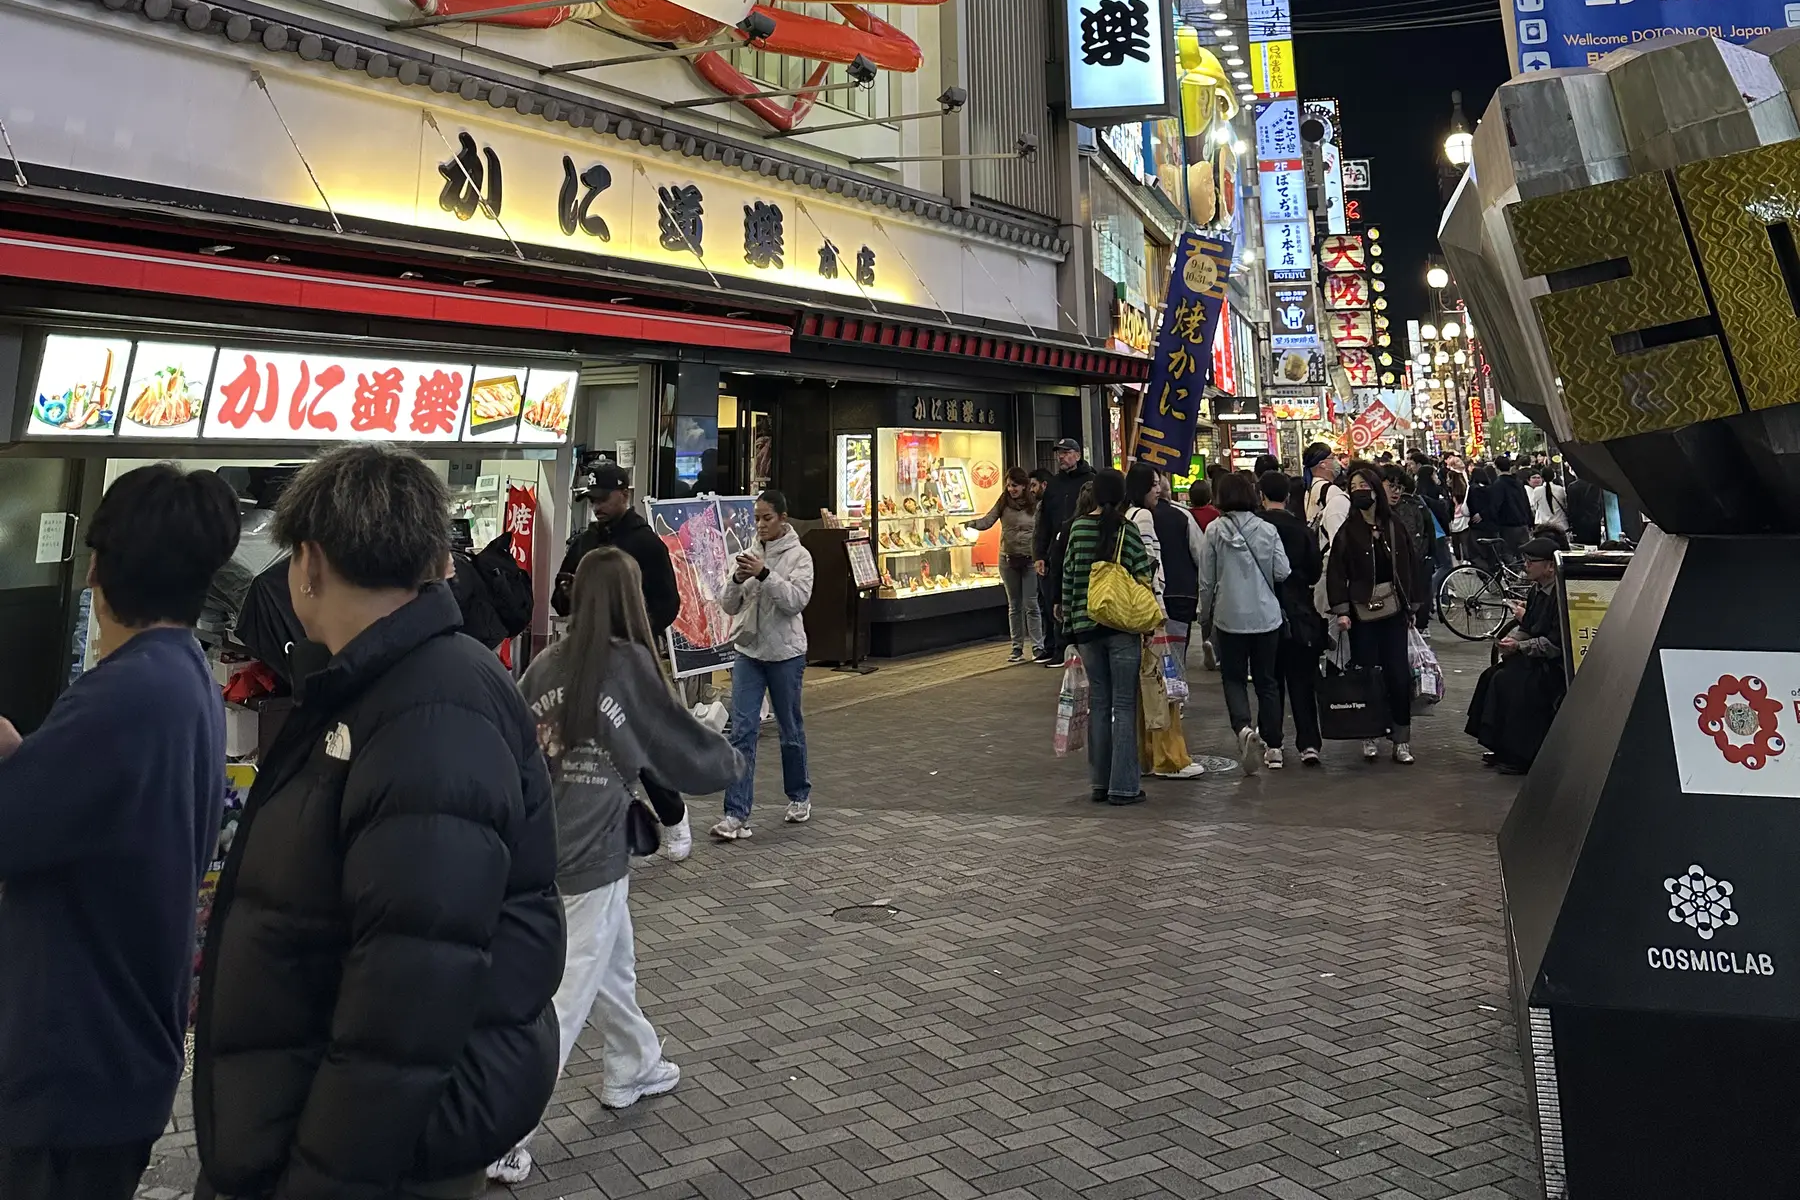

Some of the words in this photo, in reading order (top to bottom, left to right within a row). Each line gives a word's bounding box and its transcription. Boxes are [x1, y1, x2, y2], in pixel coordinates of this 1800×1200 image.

[1562, 32, 1629, 47] Wellcome
[1729, 24, 1772, 39] Japan
[1269, 45, 1285, 90] 鳥貴族
[1255, 104, 1266, 113] 3F
[1284, 107, 1297, 153] たこやき
[1274, 161, 1288, 172] 2F
[817, 238, 876, 288] 本店
[1273, 270, 1306, 280] BOTEJYU
[1275, 335, 1316, 345] 星乃珈琲店
[1159, 297, 1207, 421] 焼かに
[599, 692, 627, 729] ONG
[1647, 947, 1775, 976] COSMICLAB
